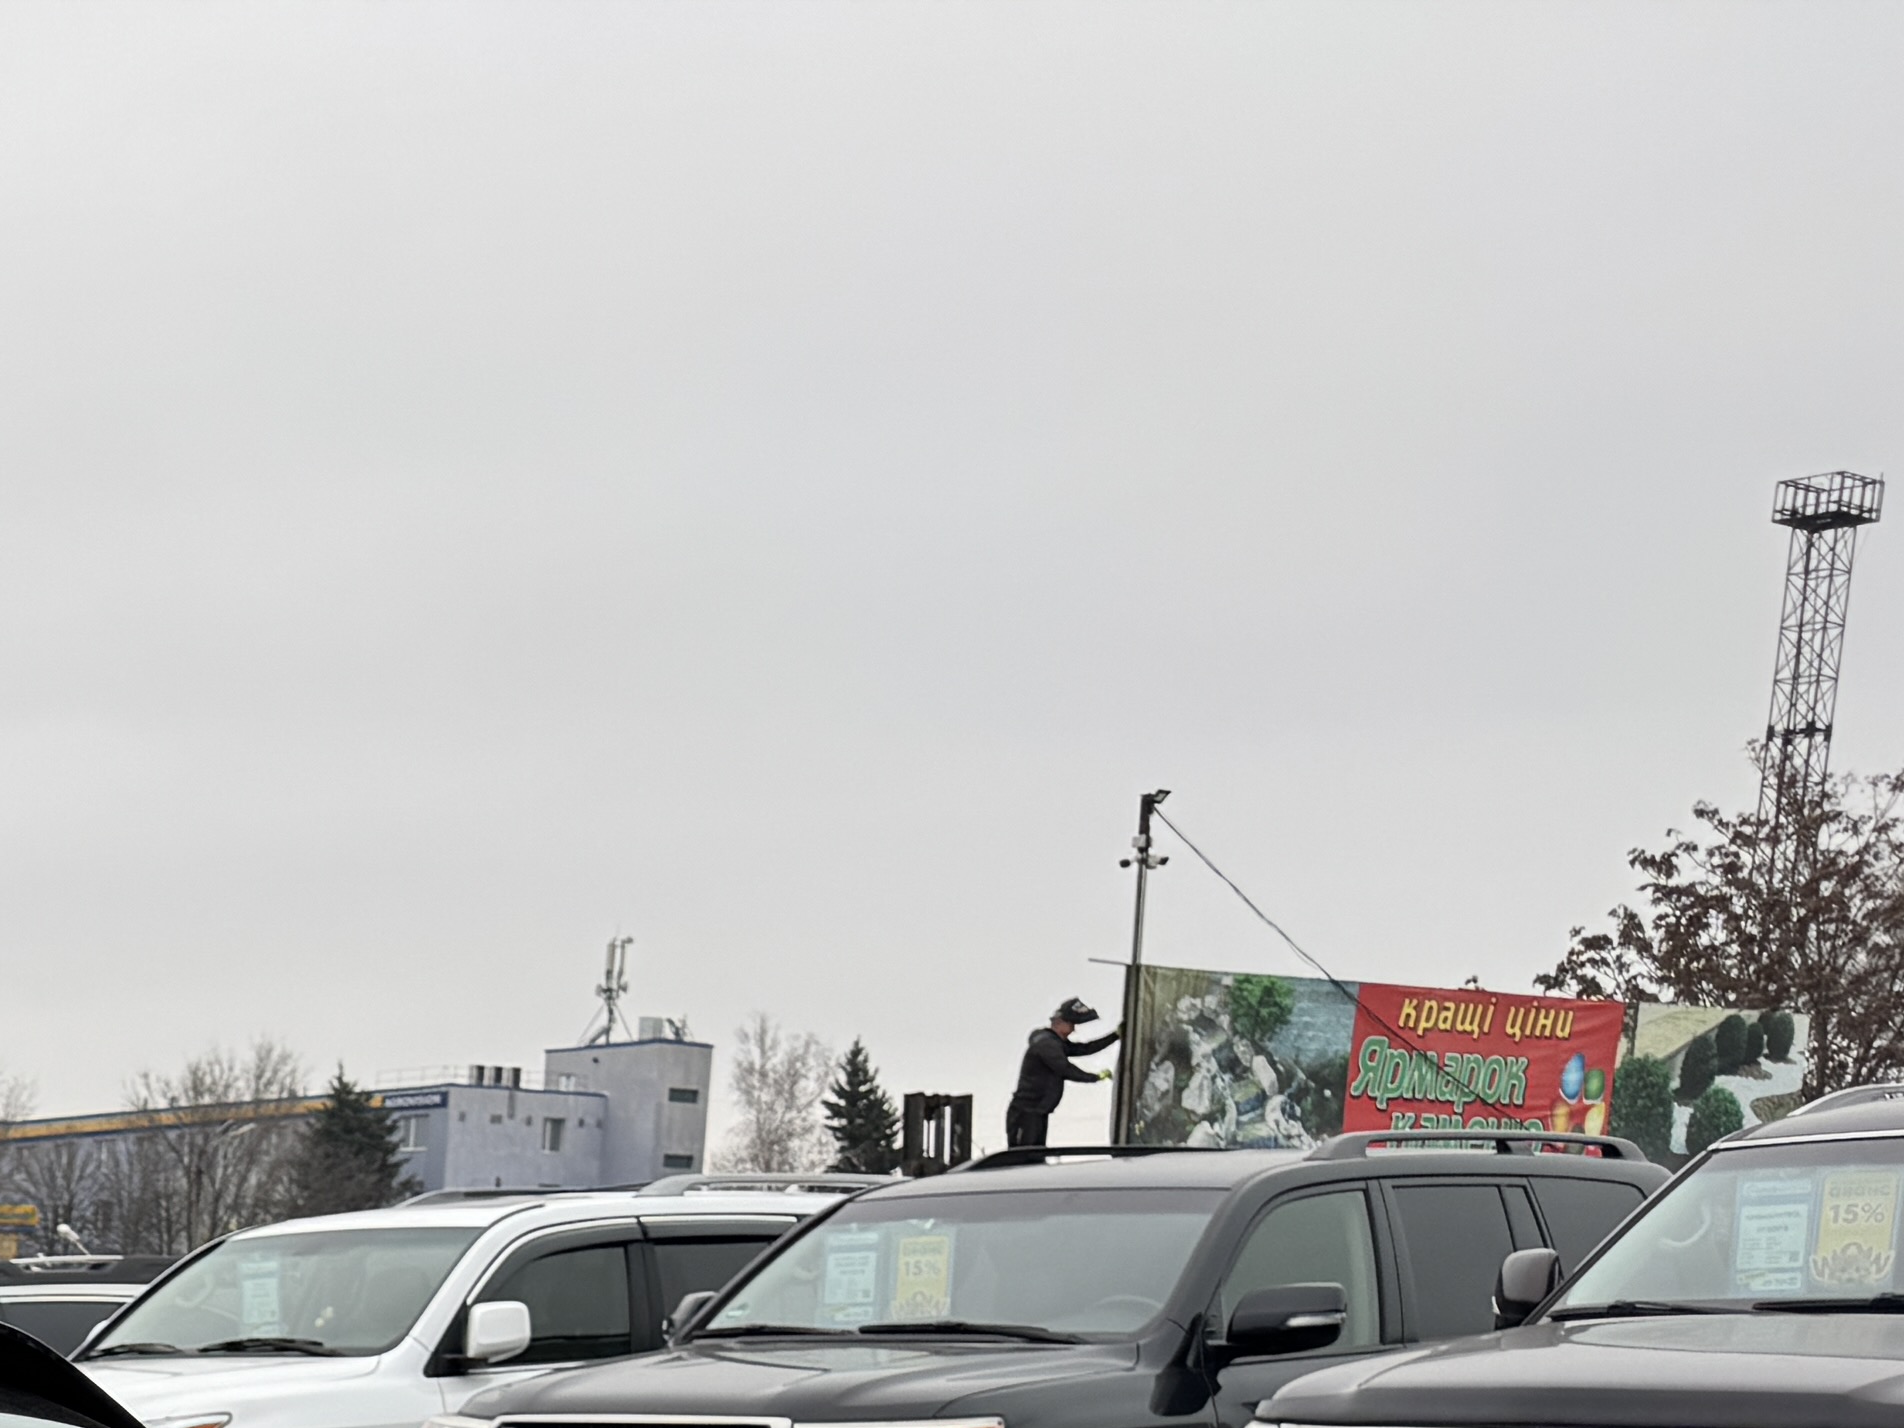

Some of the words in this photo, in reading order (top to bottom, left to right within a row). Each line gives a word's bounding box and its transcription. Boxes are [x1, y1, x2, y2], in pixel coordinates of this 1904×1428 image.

[1397, 997, 1497, 1039] кращі
[1505, 1001, 1575, 1042] ціни
[1351, 1035, 1529, 1114] Ярмарок
[1830, 1203, 1885, 1224] 15%
